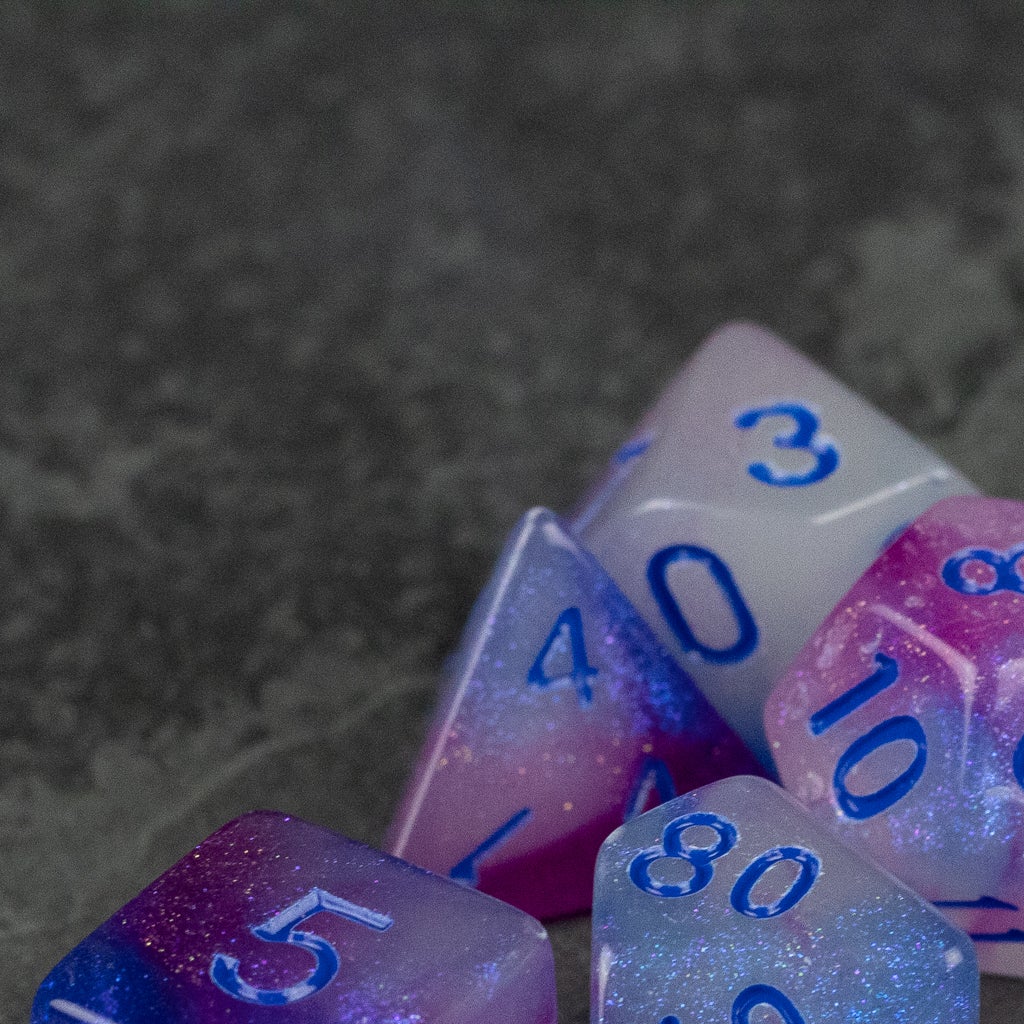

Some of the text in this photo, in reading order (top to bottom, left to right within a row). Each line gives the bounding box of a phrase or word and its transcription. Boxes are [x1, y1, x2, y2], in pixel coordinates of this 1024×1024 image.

[734, 402, 840, 488] 3
[526, 606, 600, 709] 4
[645, 542, 760, 666] 0
[809, 652, 929, 821] 10
[627, 811, 822, 919] 80
[210, 888, 394, 1006] 5
